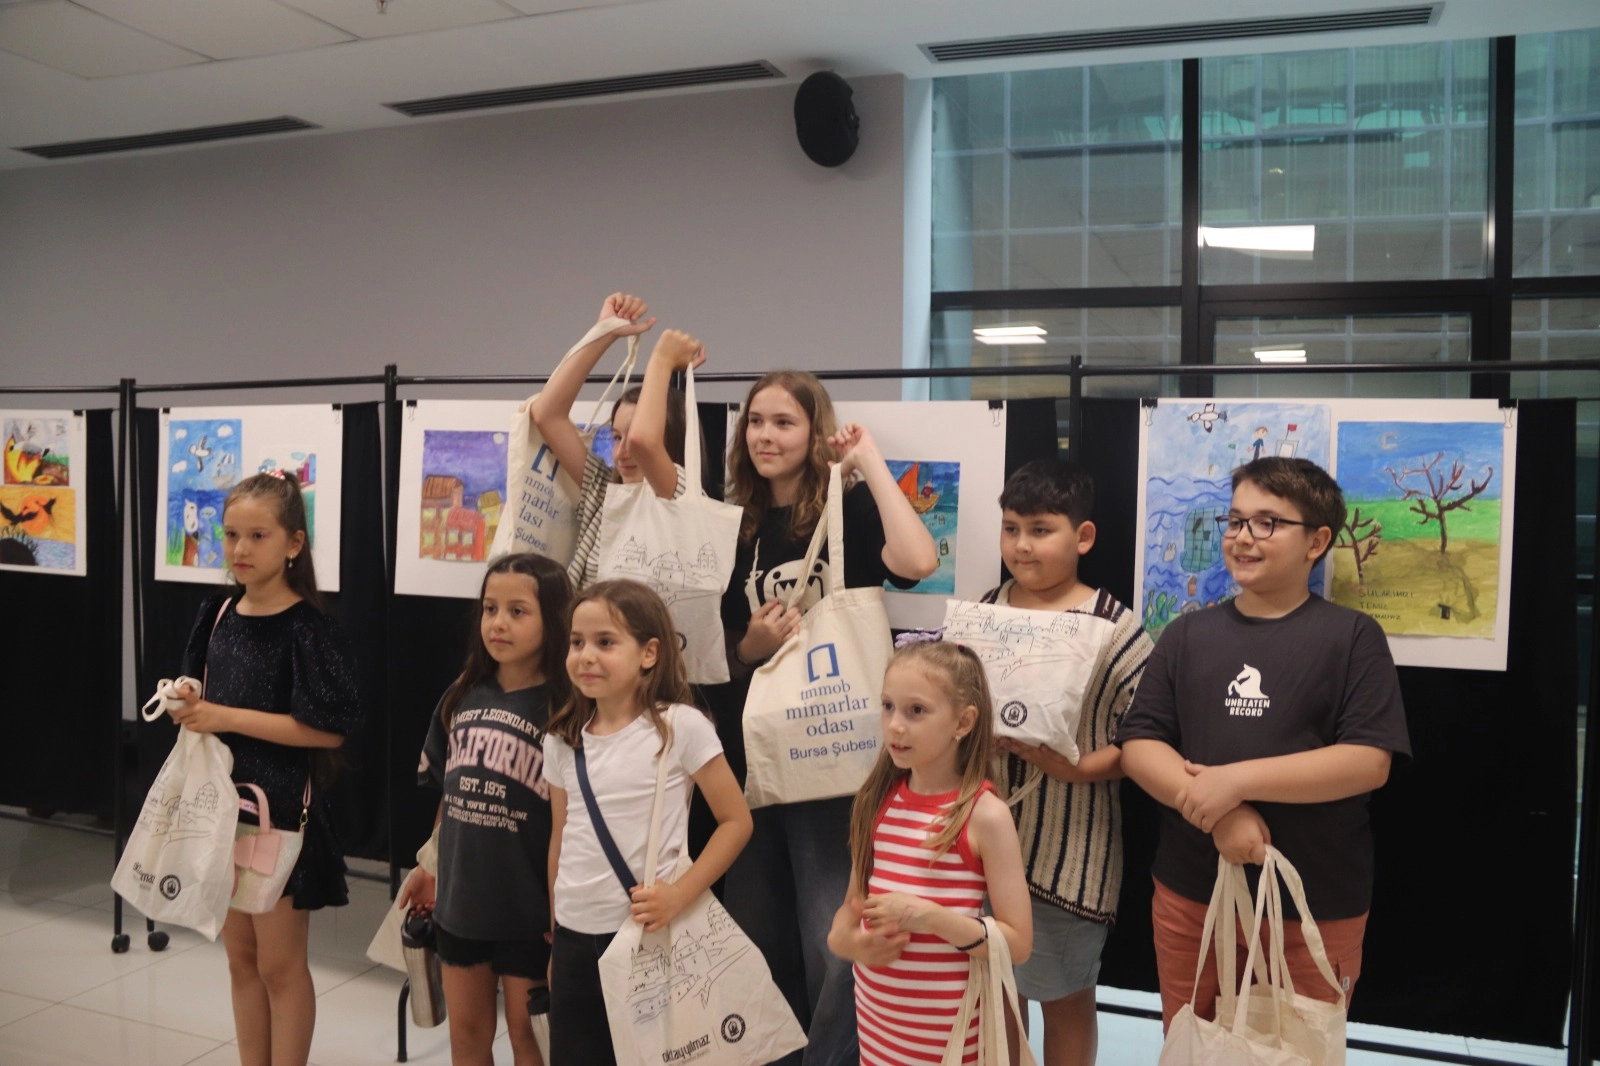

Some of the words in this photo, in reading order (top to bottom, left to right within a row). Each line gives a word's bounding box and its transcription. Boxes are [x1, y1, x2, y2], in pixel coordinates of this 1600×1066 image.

[800, 679, 851, 701] tmmob
[785, 695, 870, 721] mimarlar
[1224, 698, 1271, 708] UNBEATEN
[1229, 707, 1263, 717] RECORD
[481, 708, 540, 739] LEGENDARY
[806, 717, 855, 737] odası
[789, 745, 828, 760] Bursa
[831, 736, 877, 757] Şubesi
[459, 775, 482, 793] EST.
[483, 780, 507, 800] 1975
